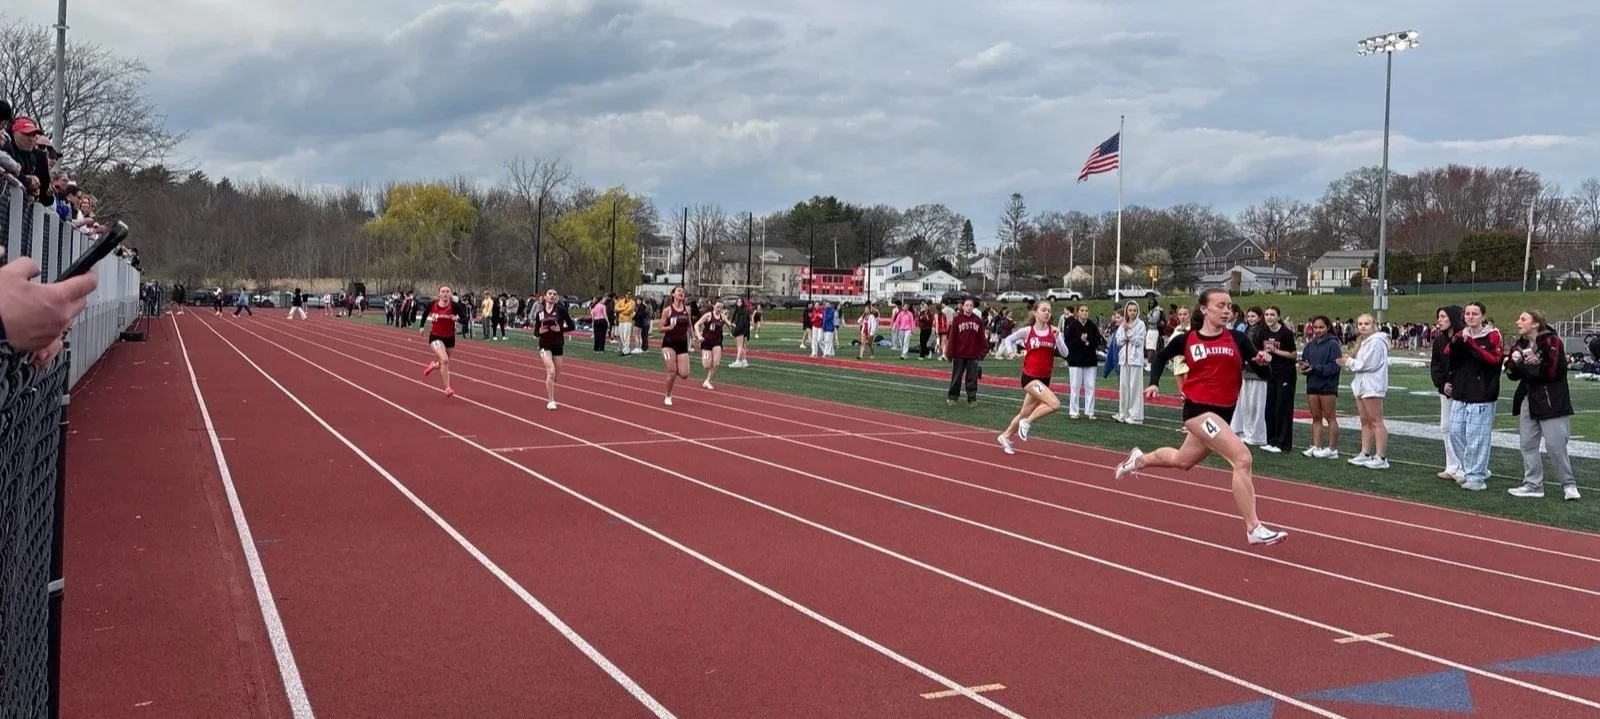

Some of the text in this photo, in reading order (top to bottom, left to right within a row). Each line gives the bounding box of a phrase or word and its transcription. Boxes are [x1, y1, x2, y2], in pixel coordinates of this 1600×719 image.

[959, 321, 979, 332] BOSTON
[1194, 345, 1204, 358] 4
[1205, 346, 1234, 357] ADING
[1034, 385, 1043, 393] 2
[1205, 420, 1218, 434] 4
